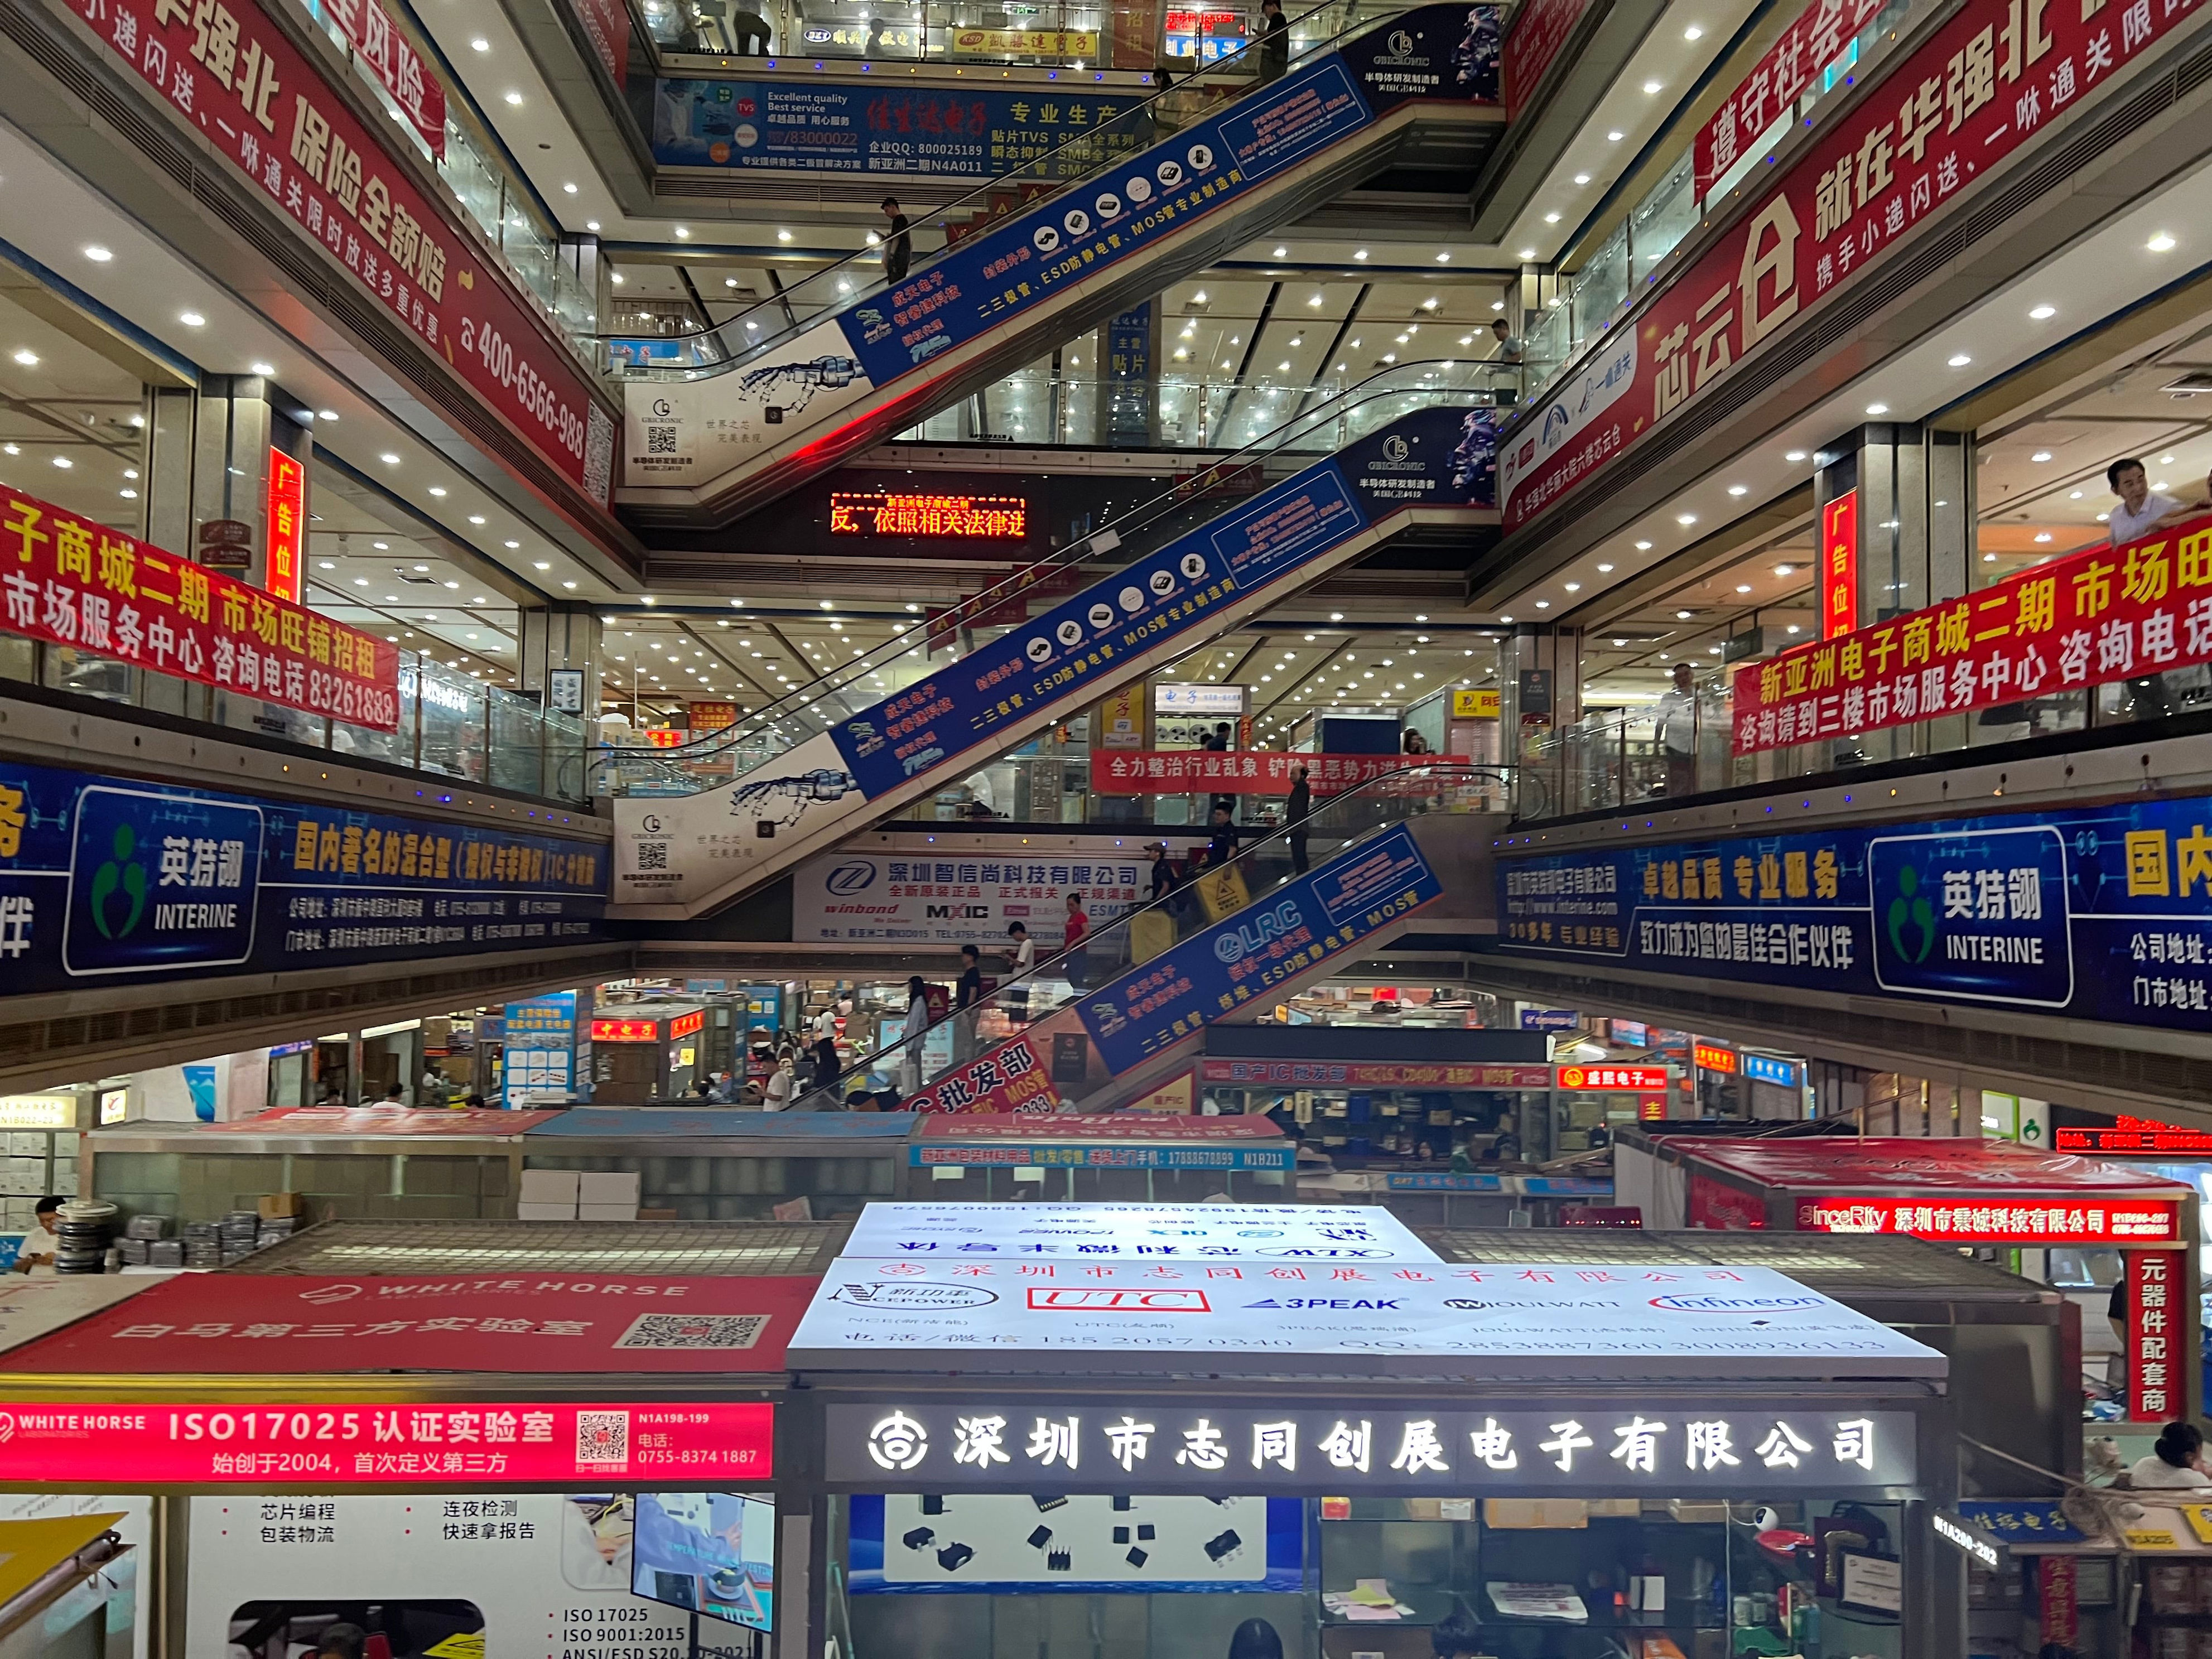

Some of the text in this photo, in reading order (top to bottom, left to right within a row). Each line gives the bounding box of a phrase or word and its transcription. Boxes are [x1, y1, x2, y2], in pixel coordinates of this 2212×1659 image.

[1365, 72, 1439, 85] 半导体研发制造者
[768, 92, 848, 105] Excellent quality
[1710, 0, 1881, 181] 遵守社会
[738, 103, 754, 112] TVS
[768, 103, 826, 113] Best service
[1010, 102, 1117, 126] 专业生产
[991, 130, 1049, 143] 贴片TVS
[290, 94, 446, 304] 保险全额赔
[478, 322, 585, 460] 400-6566-988
[2, 570, 205, 674] 市场服务中心
[213, 635, 305, 705] 咨询电话
[219, 585, 375, 680] 市场旺铺招租
[1759, 576, 2056, 706] 新亚洲电子商城二期
[1739, 643, 2047, 751] 咨询请到三楼市场服务中心
[1110, 756, 1259, 778] 全力整治行业乱象
[888, 862, 1137, 885] 深圳智信尚科技有限公司
[1643, 849, 1838, 900] 卓越品质 专业服务
[888, 885, 981, 899] 全新原装正品
[998, 886, 1058, 900] 正式报关
[155, 903, 238, 930] INTERINE
[825, 903, 900, 914] winbond
[927, 903, 988, 920] MXIC
[1238, 900, 1303, 953] LRC
[1641, 920, 1854, 970] 致力成为您的最佳合作伙伴
[1946, 934, 2045, 964] INTERINE
[1230, 1063, 1347, 1082] 国产IC批发部
[951, 1263, 1745, 1283] 深圳市志同创展电子有限公司
[378, 1278, 690, 1297] WHITE HORSE
[1044, 1291, 1191, 1307] UTC
[1285, 1298, 1400, 1310] 3PEAK
[1662, 1294, 1826, 1308] infineon
[111, 1315, 594, 1339] 白马第三方实验室
[2141, 1257, 2167, 1412] 元器件配套商
[19, 1415, 146, 1430] WHITE HORSE
[169, 1411, 555, 1444] ISO17025 认证实验室
[639, 1414, 710, 1424] N1A198-199
[952, 1415, 1875, 1474] 深圳市志同创展电子有限公司
[638, 1450, 756, 1464] 0755-8374 1887
[260, 1503, 335, 1521] 芯片编程
[442, 1500, 519, 1518] 连夜检测
[260, 1526, 335, 1544] 包装物流
[442, 1522, 536, 1540] 快速拿报告
[564, 1608, 648, 1622] ISO 17025
[563, 1627, 685, 1642] ISO 9001:2015
